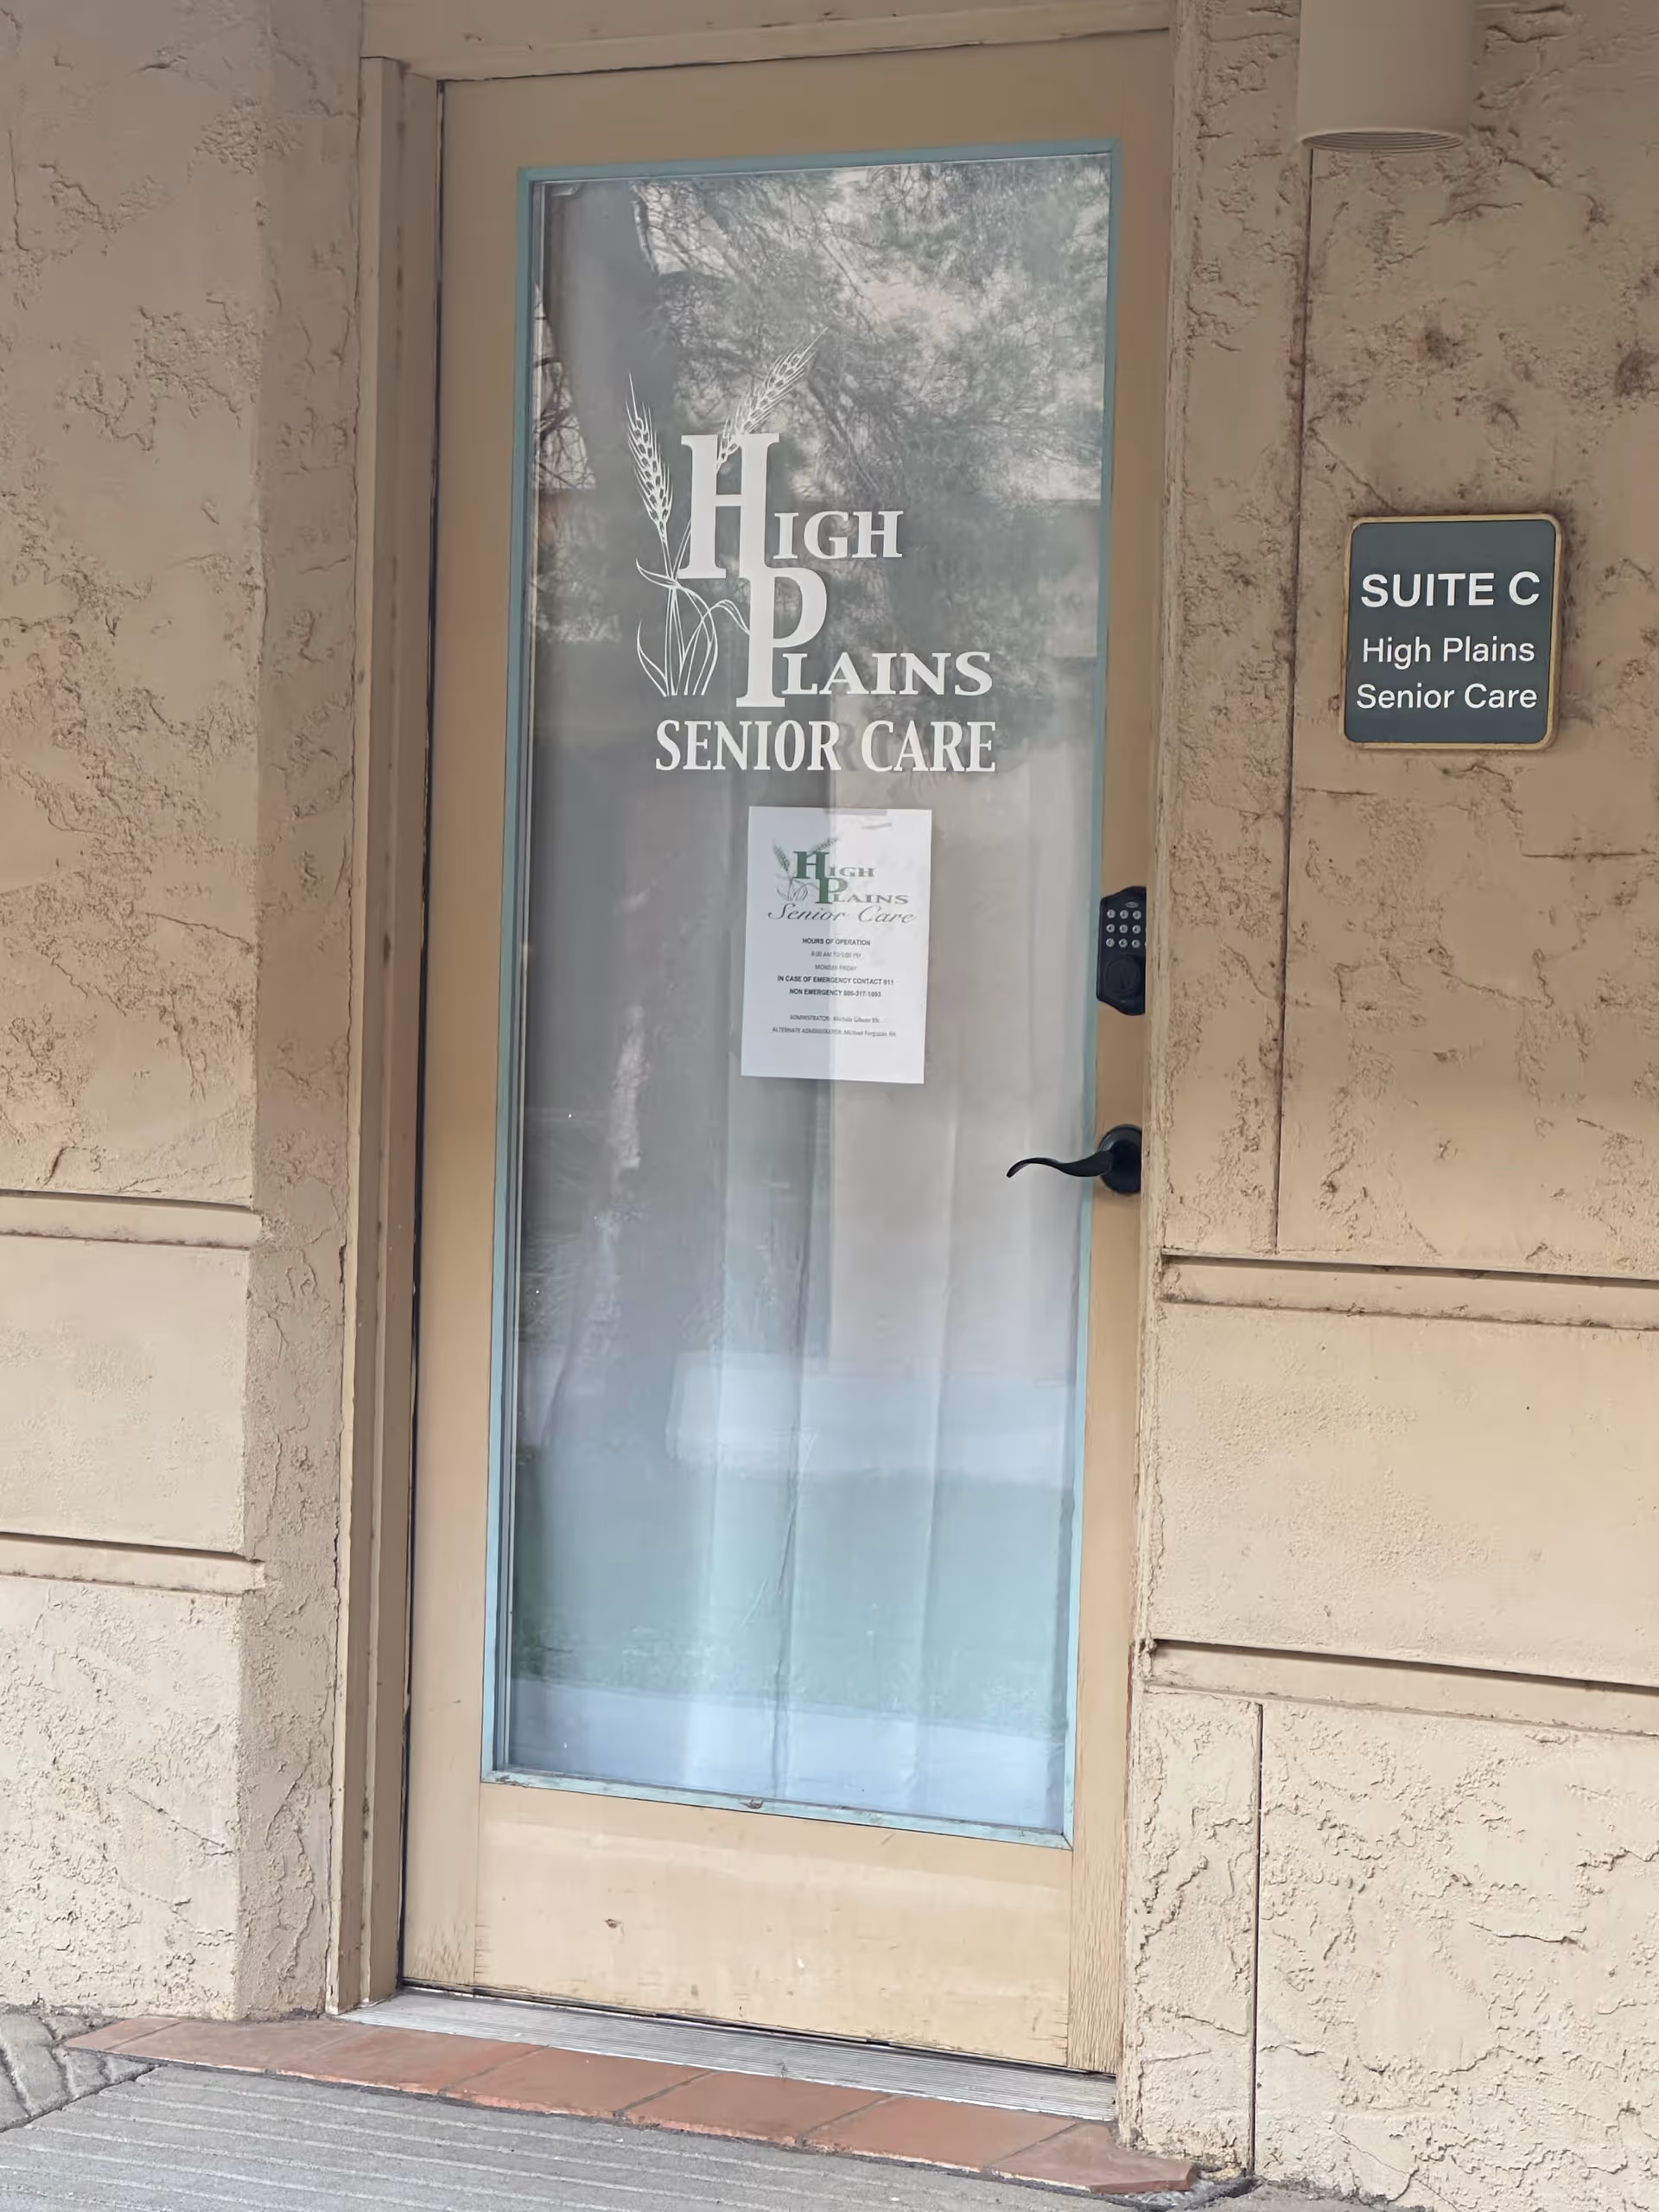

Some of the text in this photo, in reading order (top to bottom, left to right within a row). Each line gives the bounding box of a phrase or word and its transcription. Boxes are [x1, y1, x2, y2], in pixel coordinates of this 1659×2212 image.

[678, 433, 904, 579] HIGH
[1361, 571, 1540, 607] SUITE C
[736, 566, 993, 708] PLAINS
[1363, 636, 1535, 670] High Plains
[1357, 683, 1538, 709] Senior Care
[656, 720, 996, 772] SENIOR CARE
[793, 851, 875, 879] HIGH
[815, 876, 908, 904] PLAINS
[767, 903, 918, 924] Senior Care
